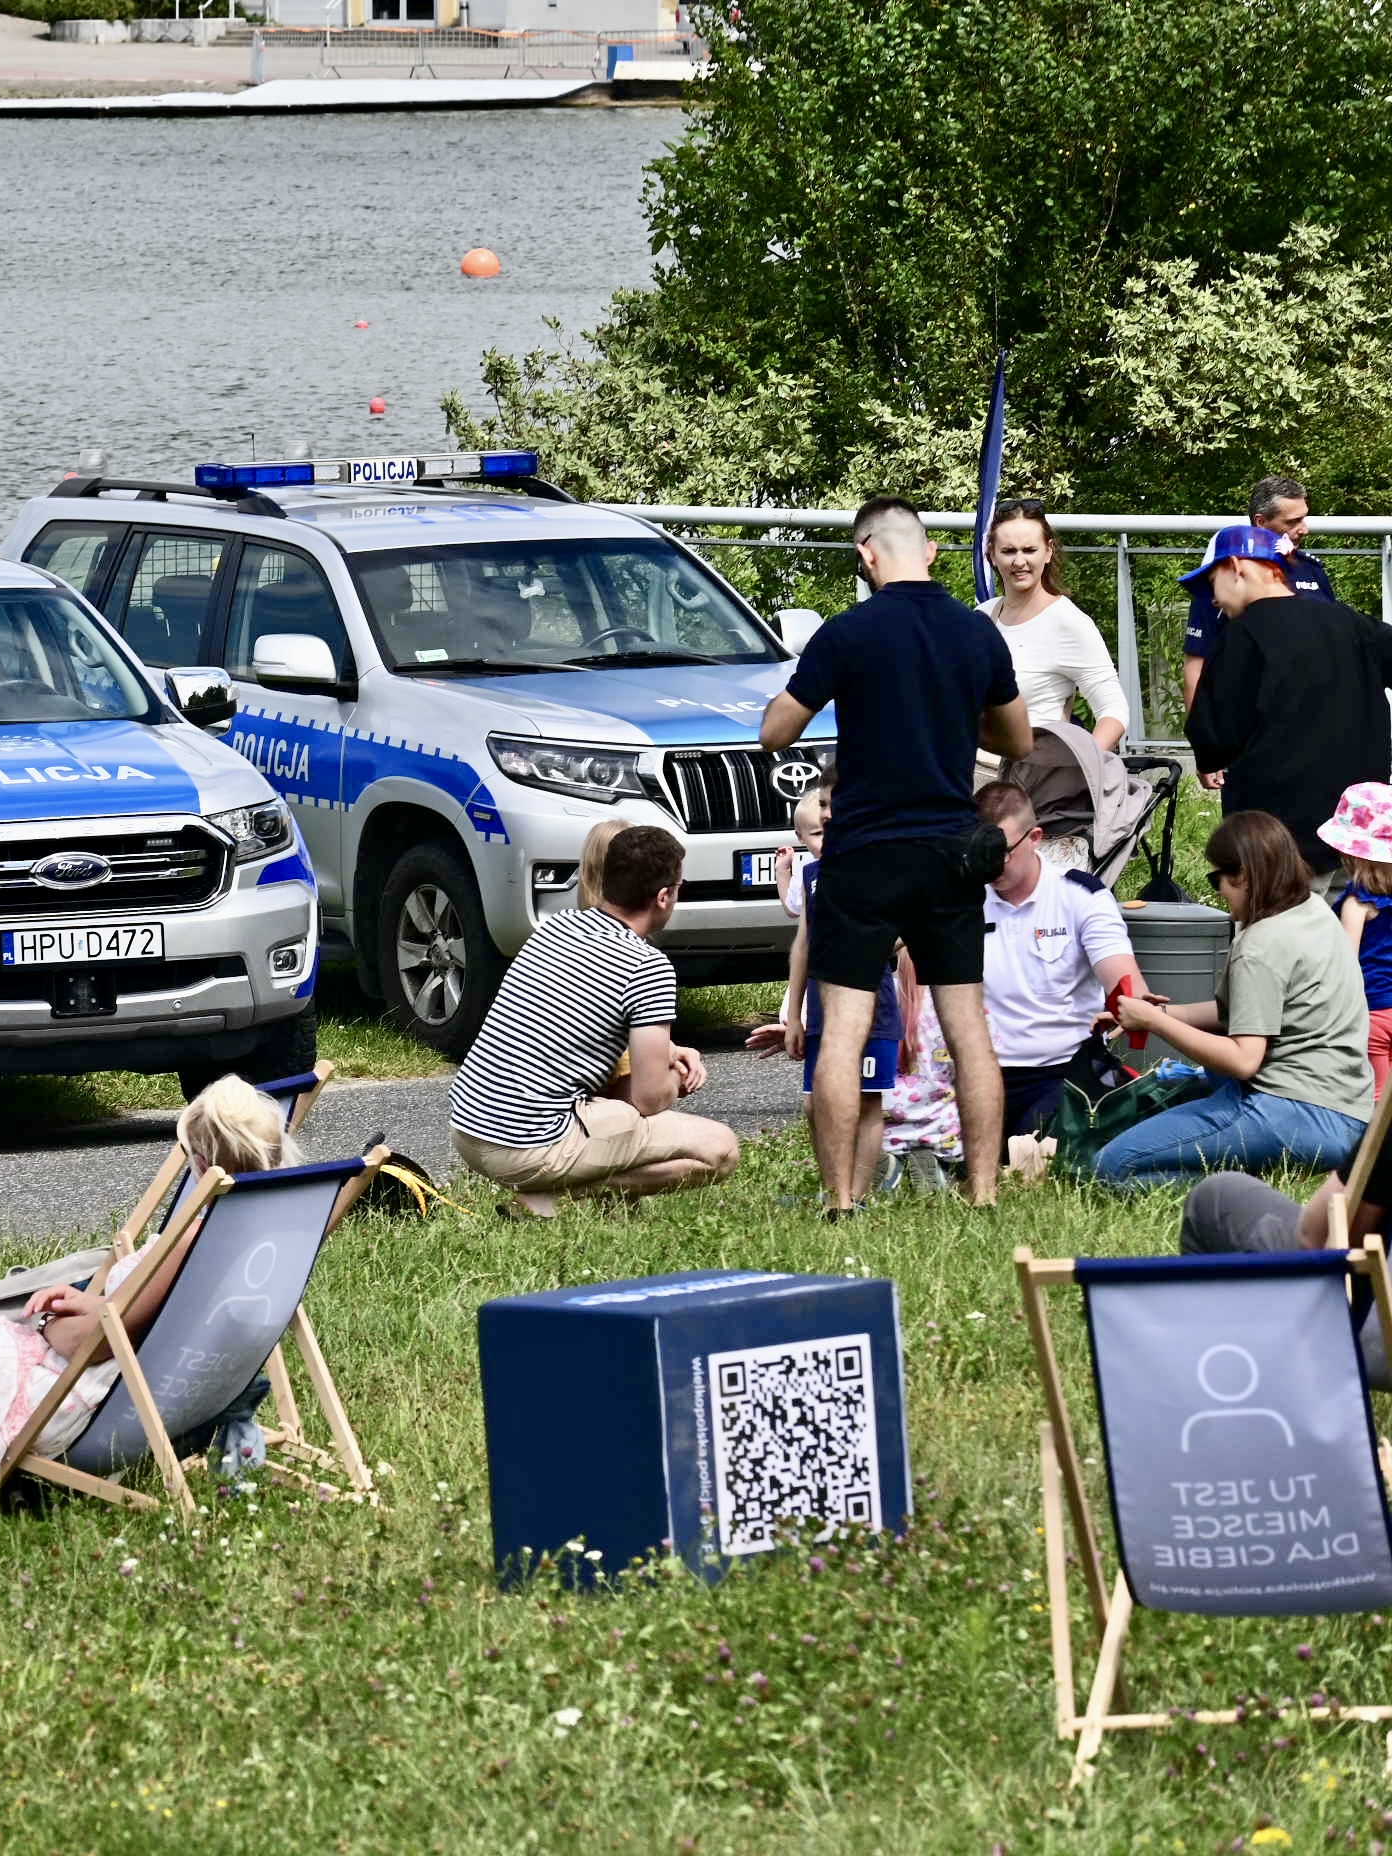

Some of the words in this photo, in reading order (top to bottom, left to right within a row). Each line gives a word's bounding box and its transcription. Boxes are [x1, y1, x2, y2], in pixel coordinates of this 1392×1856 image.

[353, 460, 416, 481] POLICJA
[56, 860, 95, 877] Ford
[20, 931, 75, 961] HPU
[86, 928, 154, 958] D472
[2, 952, 14, 961] PL
